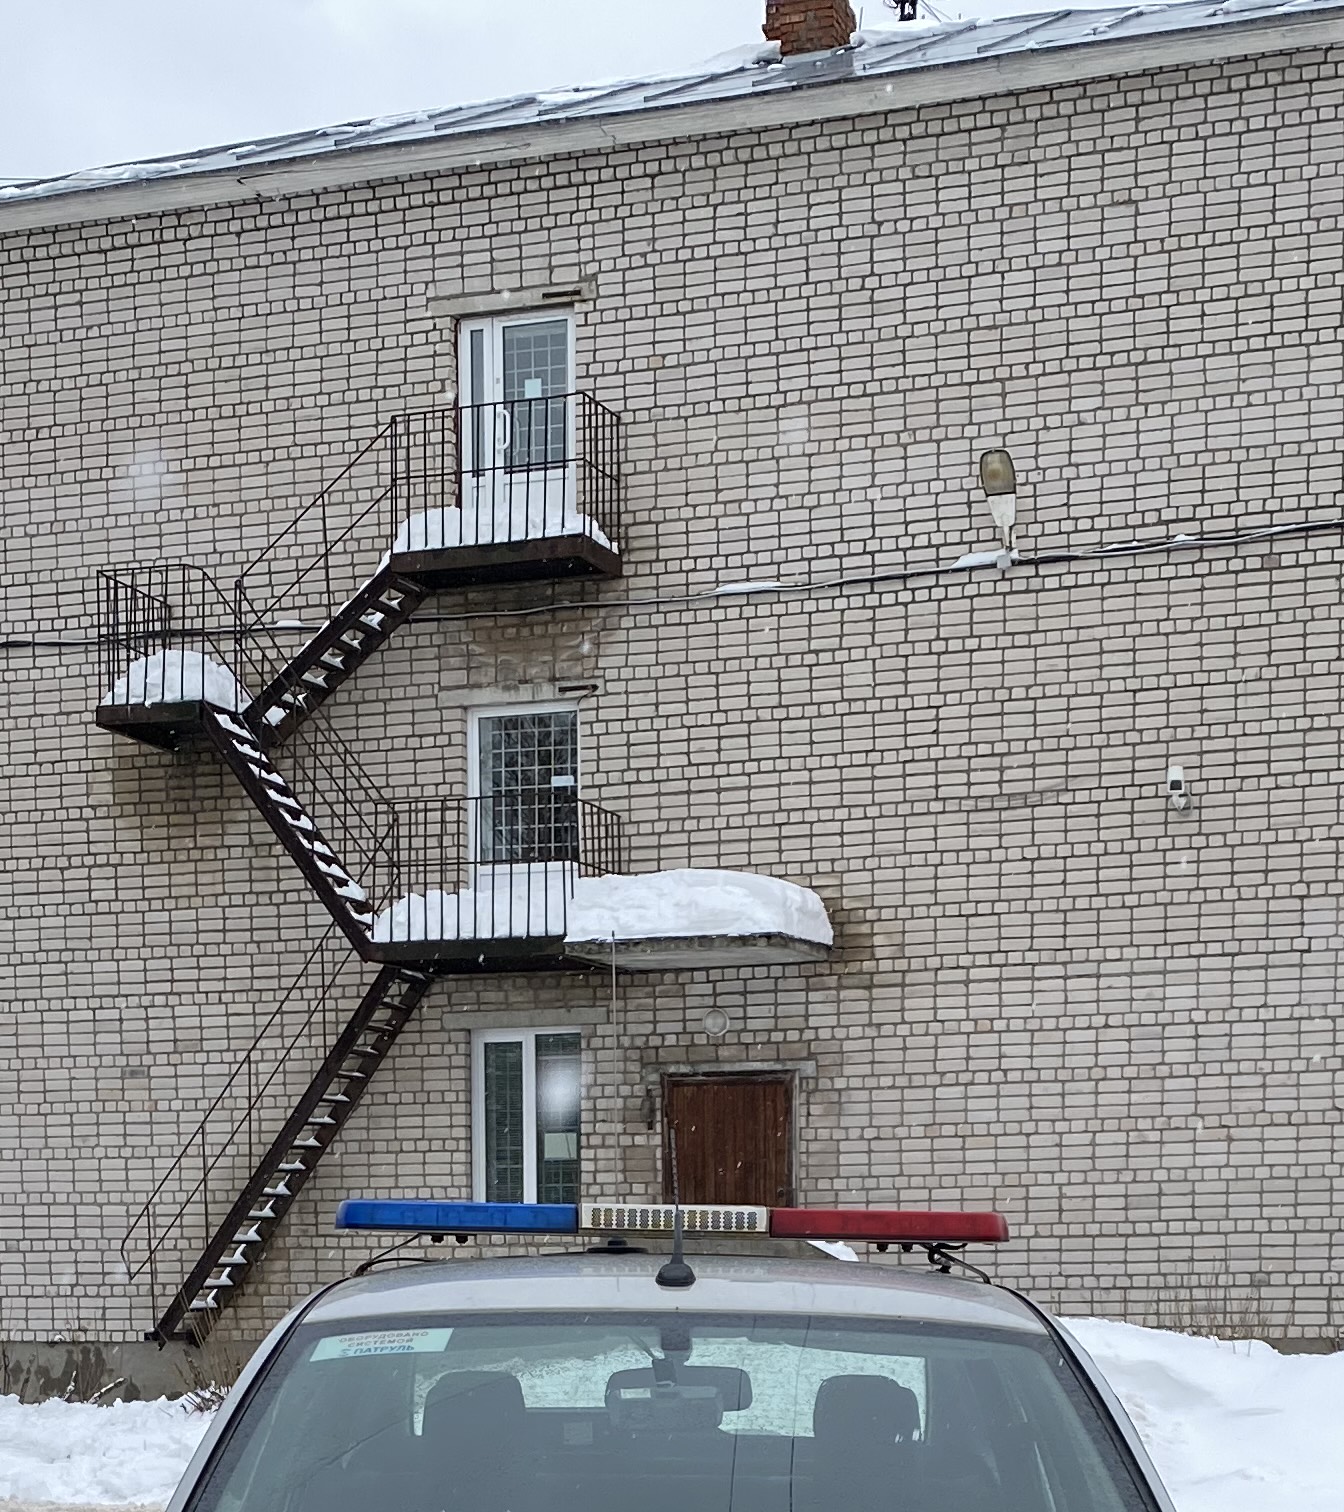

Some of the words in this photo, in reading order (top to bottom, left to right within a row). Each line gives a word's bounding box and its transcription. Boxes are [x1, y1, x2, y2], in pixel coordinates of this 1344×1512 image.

[338, 1331, 429, 1343] ОБОРУДОВАНО
[348, 1338, 414, 1348] СИСТЕМОЙ
[353, 1345, 415, 1355] ПАТРУЛЬ
